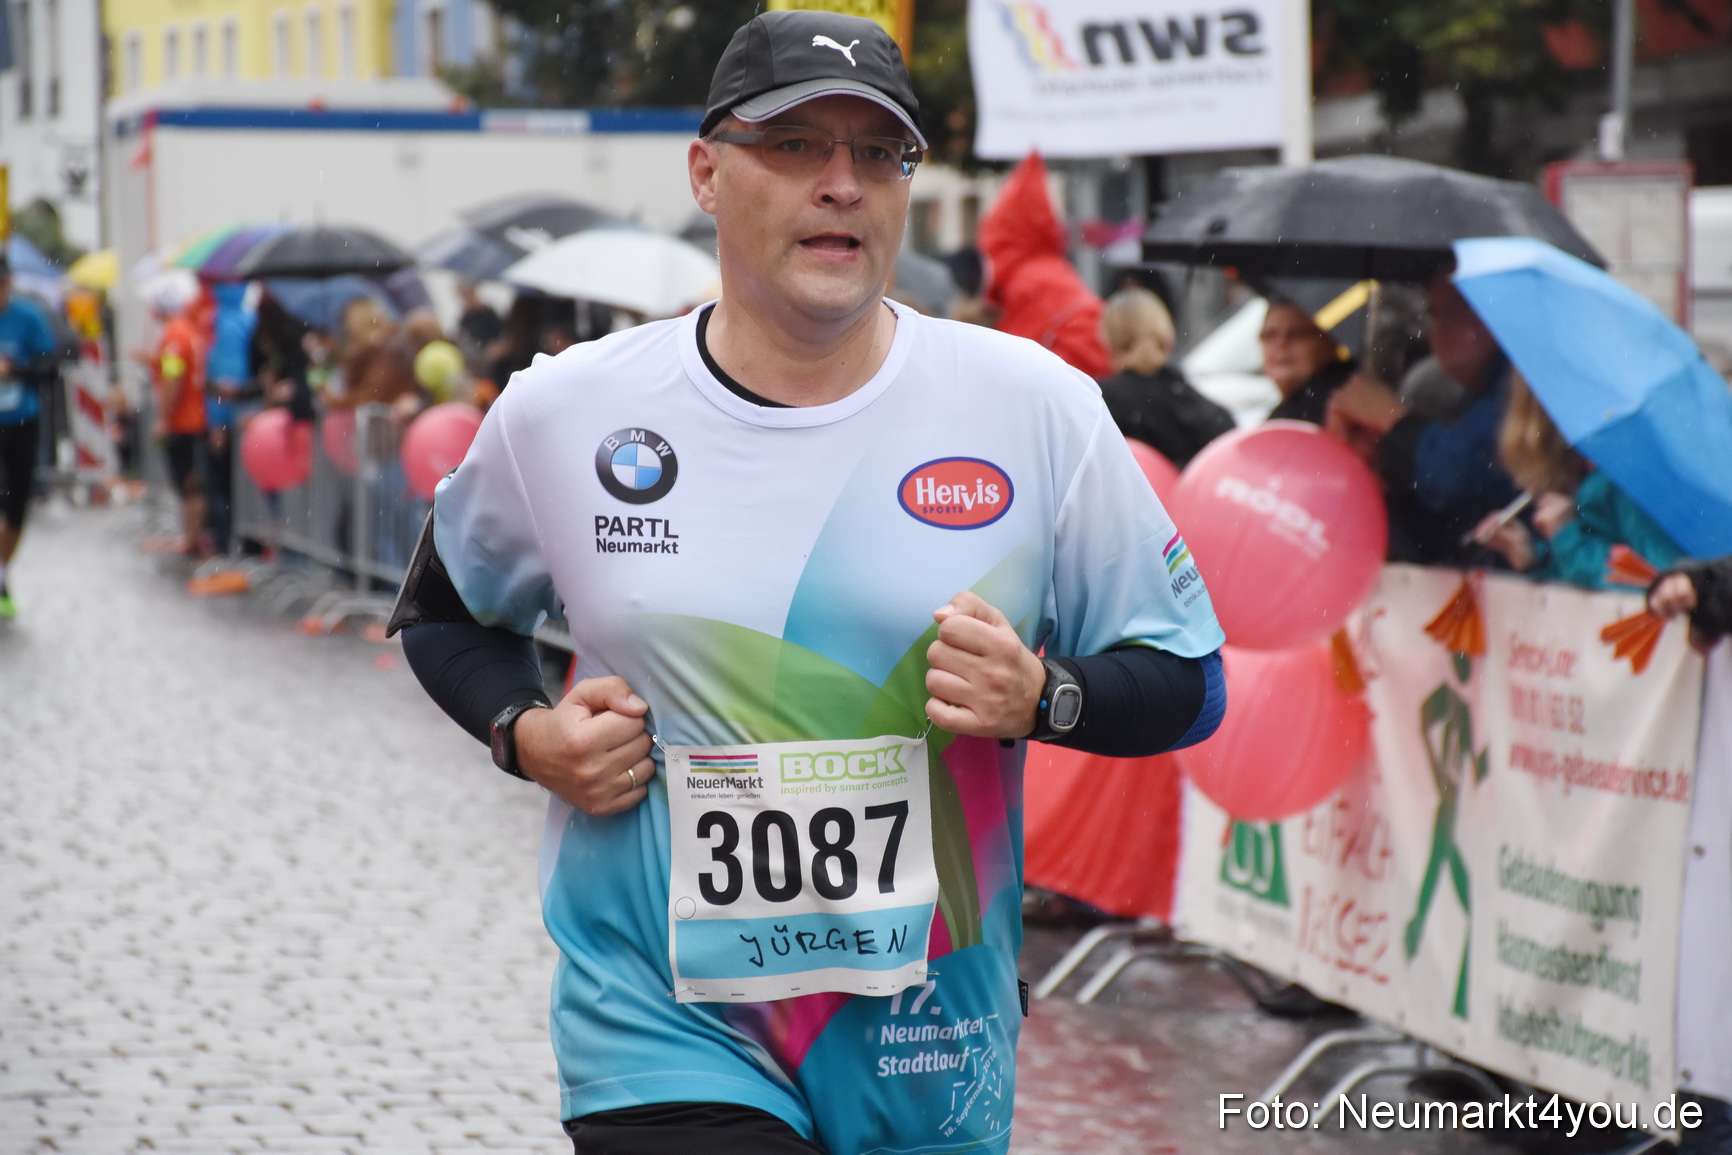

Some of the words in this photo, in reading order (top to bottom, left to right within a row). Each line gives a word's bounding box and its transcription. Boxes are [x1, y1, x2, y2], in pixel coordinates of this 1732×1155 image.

[604, 429, 673, 458] BMW
[915, 477, 1001, 511] Hervis
[922, 506, 964, 515] SPORTS
[594, 515, 680, 539] PARTL
[596, 537, 679, 555] Neumarkt
[1170, 562, 1200, 600] Neu
[779, 744, 906, 783] BOCK
[686, 776, 764, 789] NeuerMarkt
[780, 784, 822, 796] inspired
[824, 783, 837, 794] by
[840, 782, 870, 792] smart
[871, 776, 909, 790] concepts
[696, 799, 910, 907] 3087
[739, 924, 908, 968] JÜRGEN
[880, 1016, 984, 1046] Neumarkter
[876, 1046, 971, 1078] Stadtlauf
[955, 1072, 986, 1126] September
